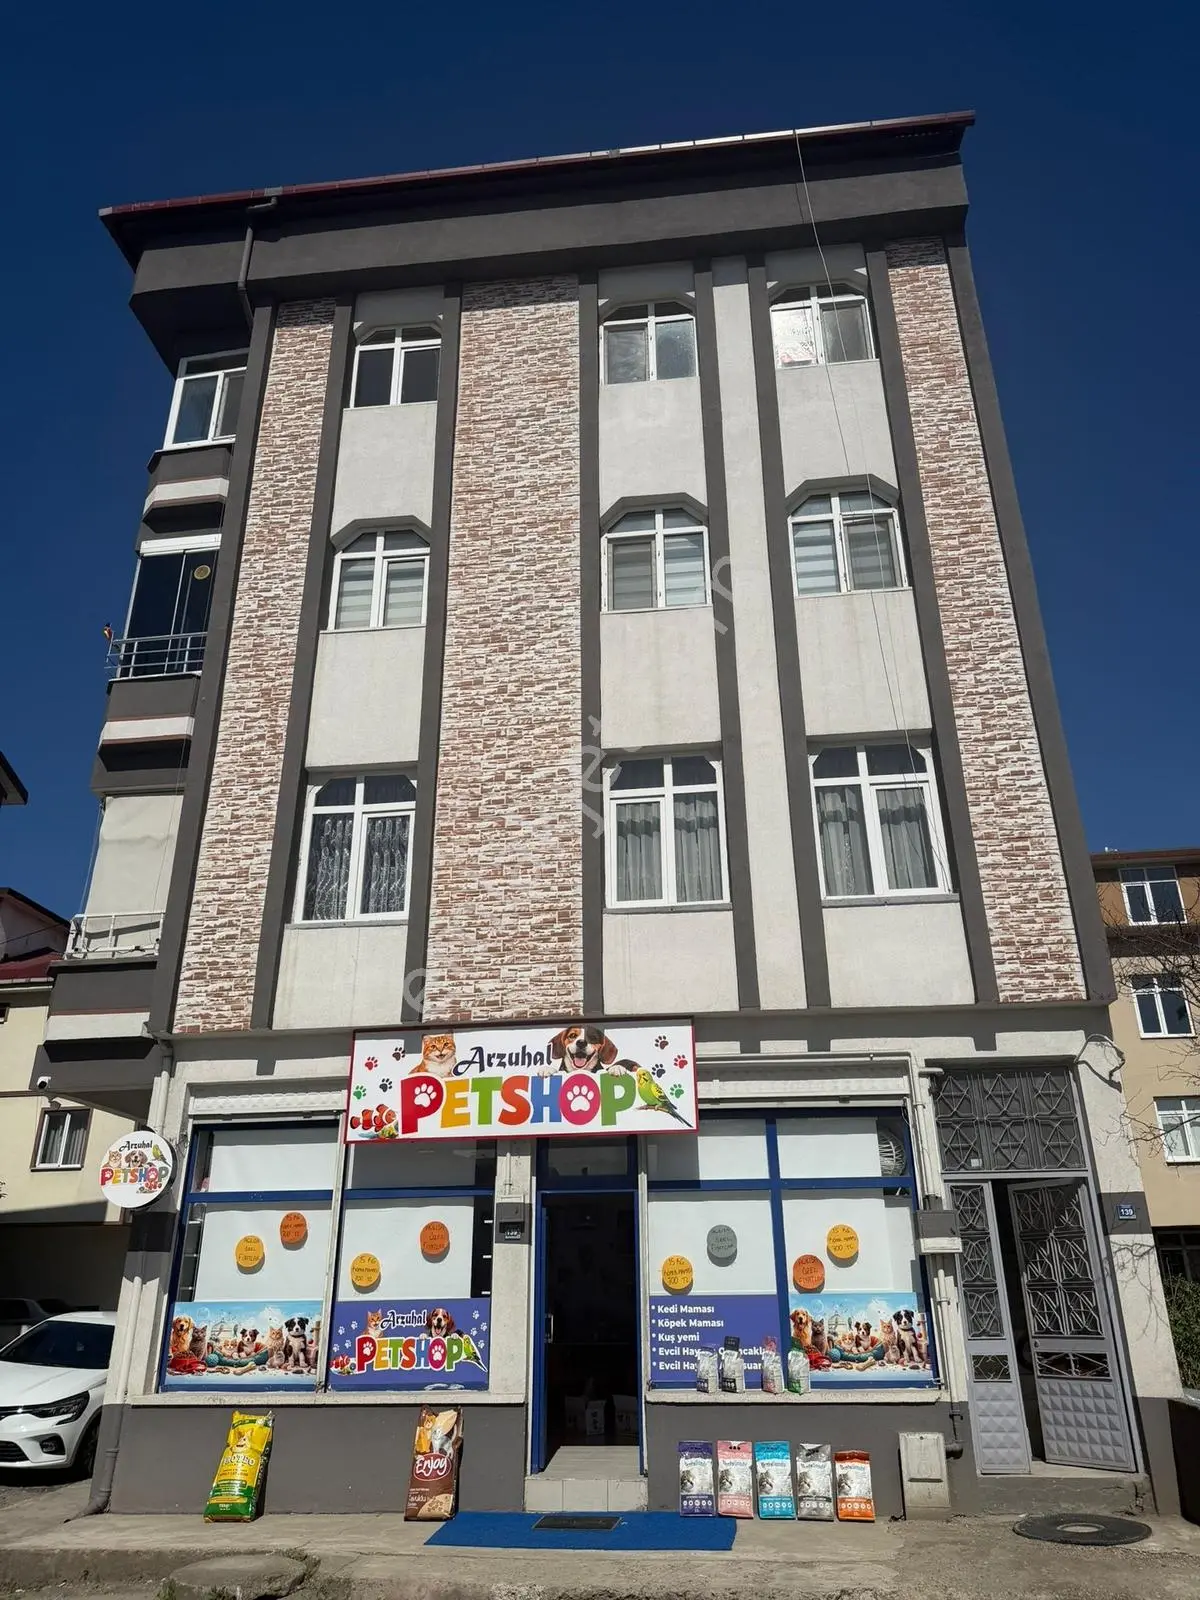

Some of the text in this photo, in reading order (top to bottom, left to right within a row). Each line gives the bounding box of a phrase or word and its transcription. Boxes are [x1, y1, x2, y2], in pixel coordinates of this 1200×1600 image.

[453, 1044, 552, 1075] Arzuhal
[401, 1074, 636, 1135] PETSHOP
[100, 1166, 169, 1186] PETSHOP
[657, 1304, 715, 1313] Kedi Maması
[380, 1310, 427, 1329] Arzuhal
[658, 1319, 724, 1329] Köpek Maması
[658, 1332, 700, 1344] Kuş yemi
[356, 1335, 464, 1373] PETSHOP
[659, 1347, 681, 1356] Evcil
[659, 1361, 681, 1371] Evcil
[415, 1454, 448, 1477] Enjoy
